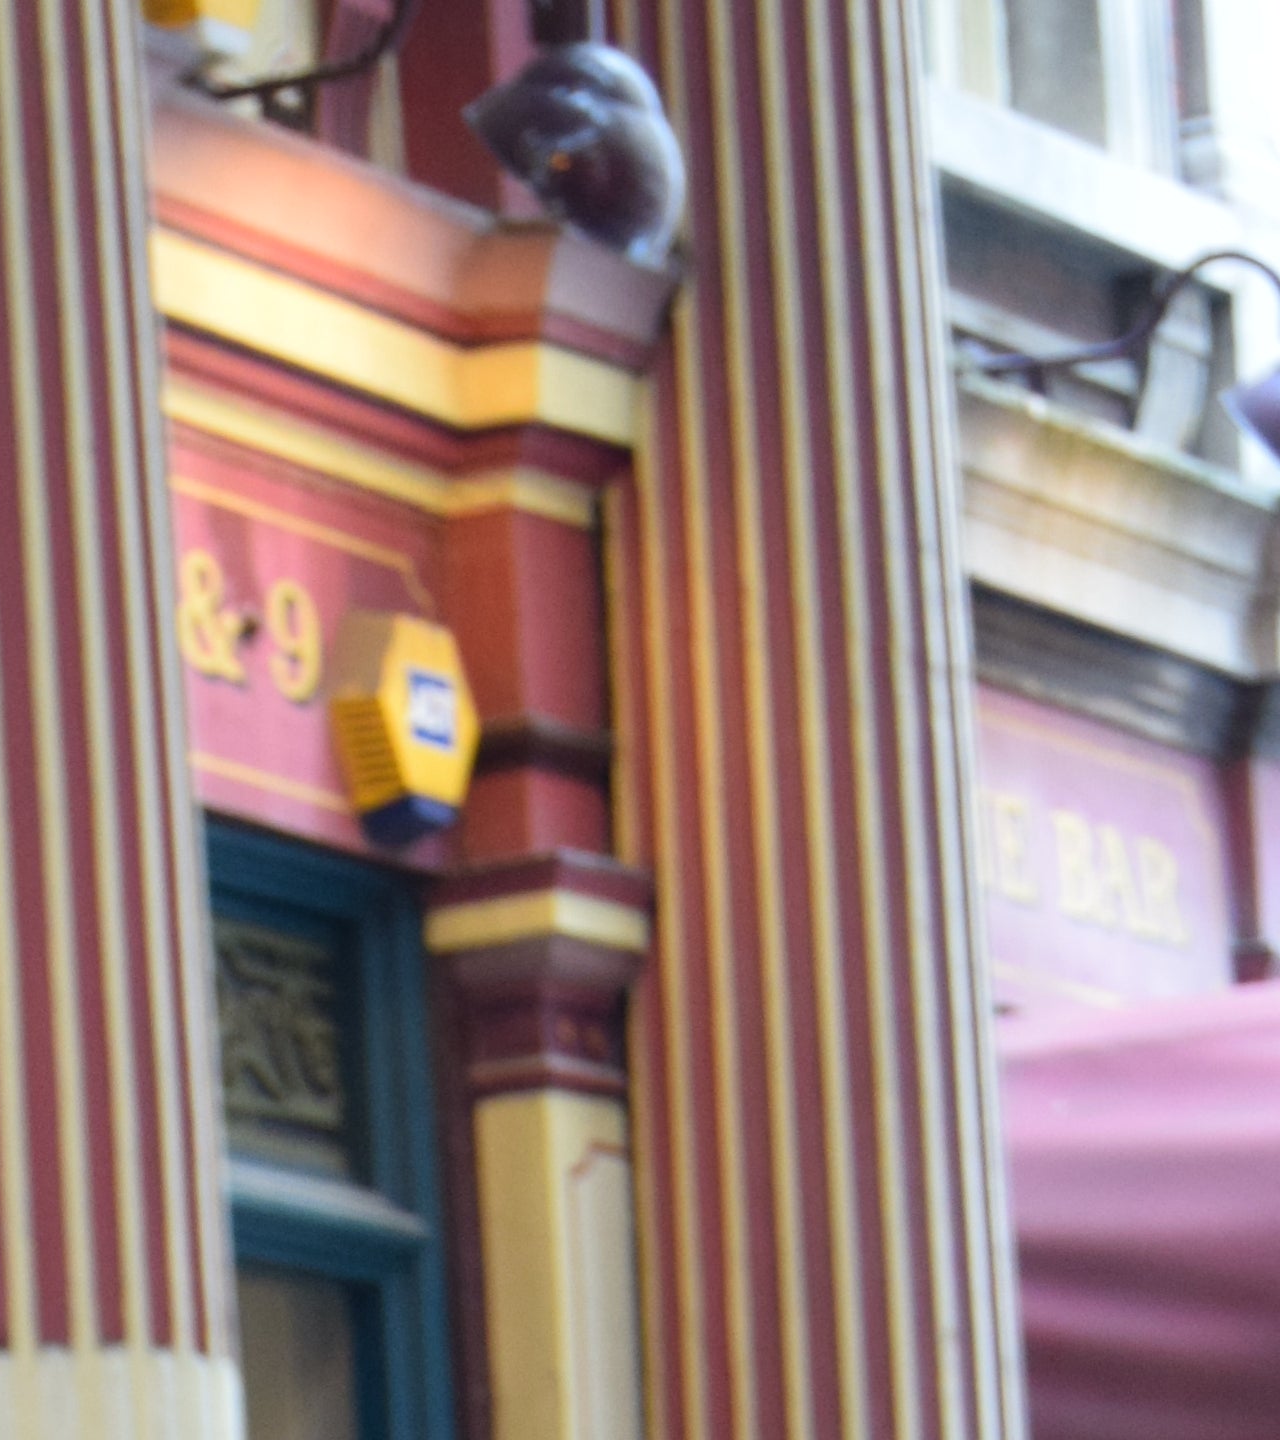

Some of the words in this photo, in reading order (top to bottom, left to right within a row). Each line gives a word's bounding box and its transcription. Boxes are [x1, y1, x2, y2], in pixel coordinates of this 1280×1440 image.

[177, 547, 246, 685] &
[266, 577, 321, 704] 9
[1051, 808, 1192, 949] BAR
